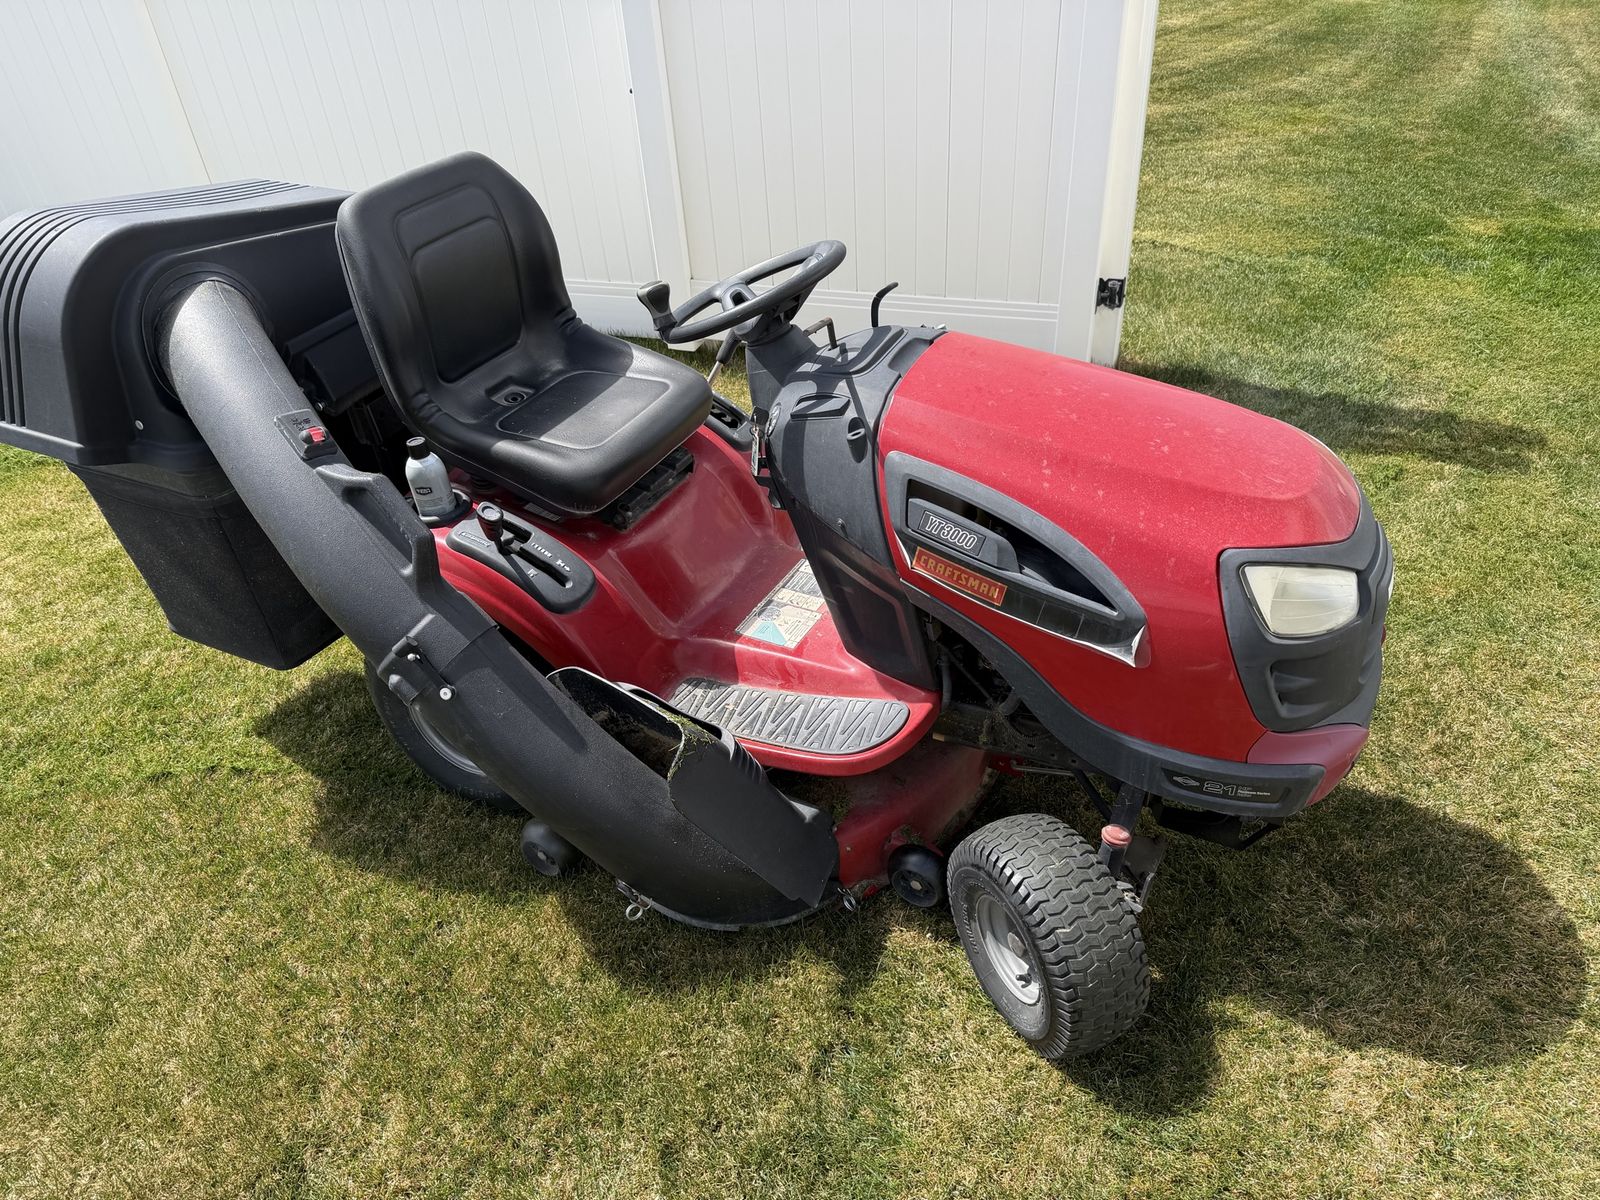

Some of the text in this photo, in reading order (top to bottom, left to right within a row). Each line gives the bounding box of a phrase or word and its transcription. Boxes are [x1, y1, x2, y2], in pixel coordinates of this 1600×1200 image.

[925, 515, 978, 549] YT3000
[919, 555, 1000, 599] CRAFTSMAN
[1203, 780, 1237, 796] 21
